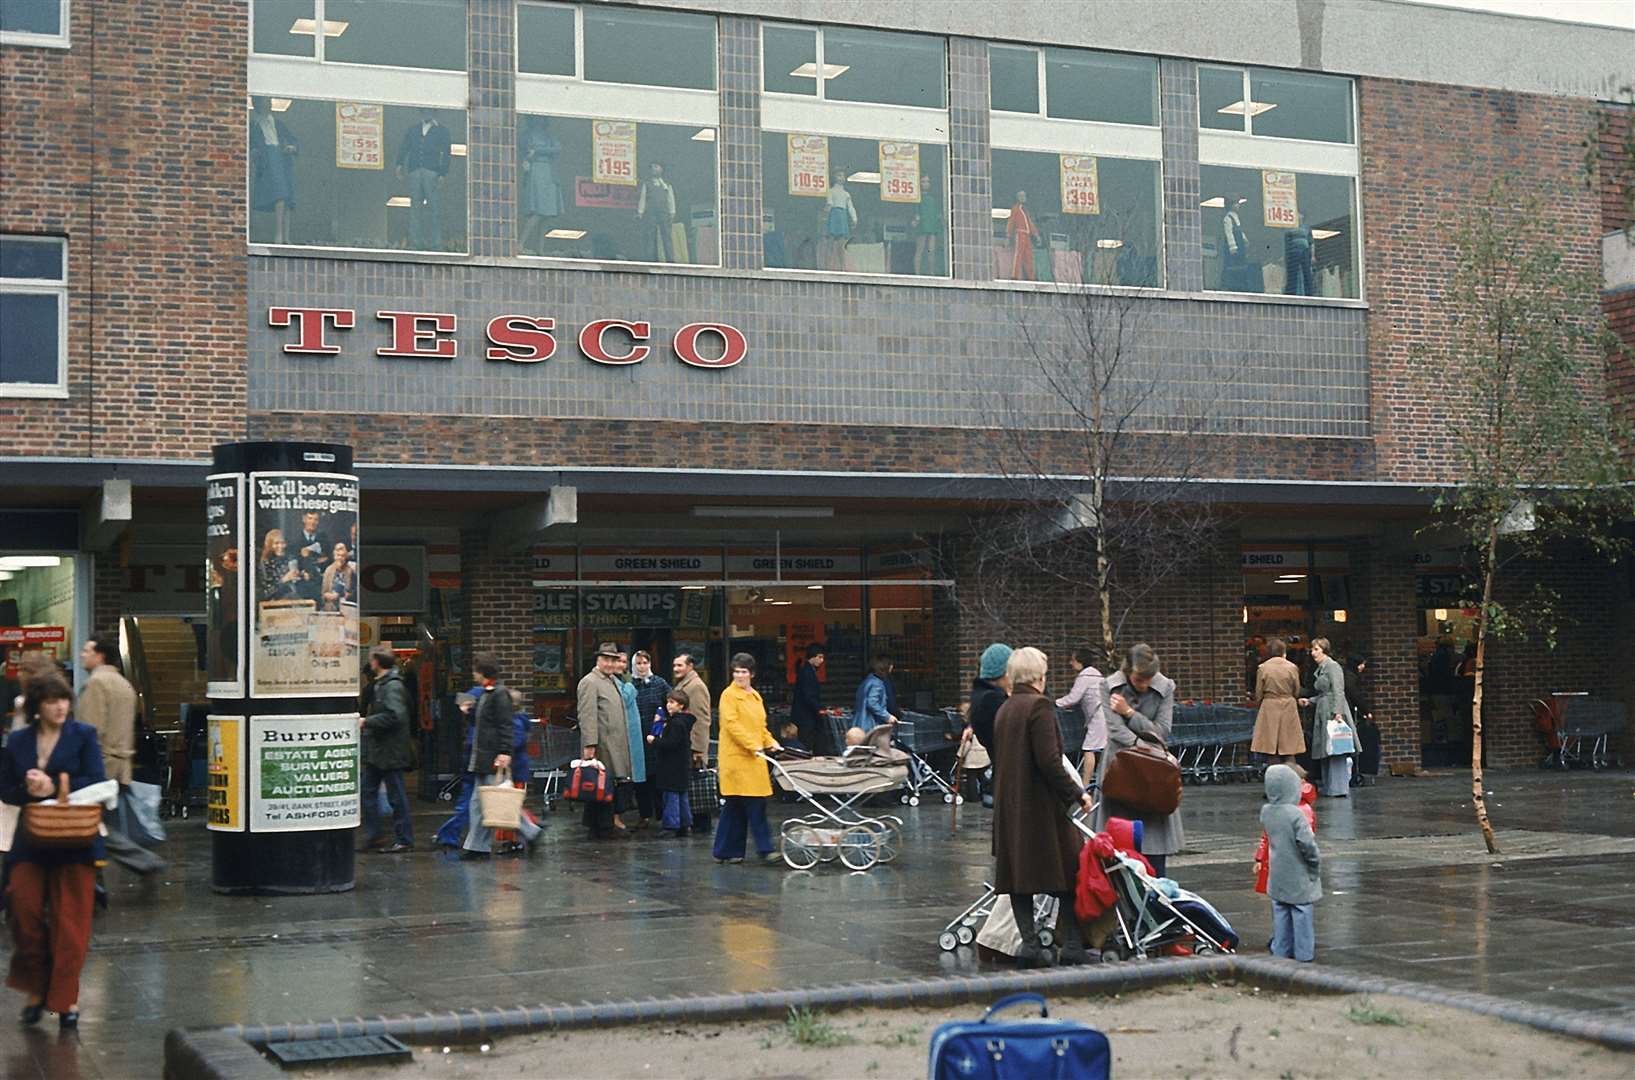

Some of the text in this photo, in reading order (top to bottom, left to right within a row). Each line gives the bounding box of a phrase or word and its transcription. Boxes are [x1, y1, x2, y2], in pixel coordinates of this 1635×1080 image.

[268, 306, 748, 370] TESCO
[258, 480, 296, 495] You'll
[298, 480, 317, 495] be
[317, 482, 342, 497] 25%
[258, 494, 291, 509] with
[292, 494, 329, 510] these
[615, 558, 701, 569] GREEN SHIELD
[794, 558, 834, 570] SHIELD
[1249, 554, 1283, 565] SHIELD
[533, 593, 676, 610] BLE STAMPS
[263, 729, 351, 742] Burrows
[264, 747, 358, 760] ESTATE AGENT
[281, 759, 354, 771] SURVEYORS
[294, 771, 349, 782] VALUERS
[272, 782, 355, 795] AUCTIONEERS
[265, 812, 281, 820] Tel
[285, 810, 339, 820] ASHFORD
